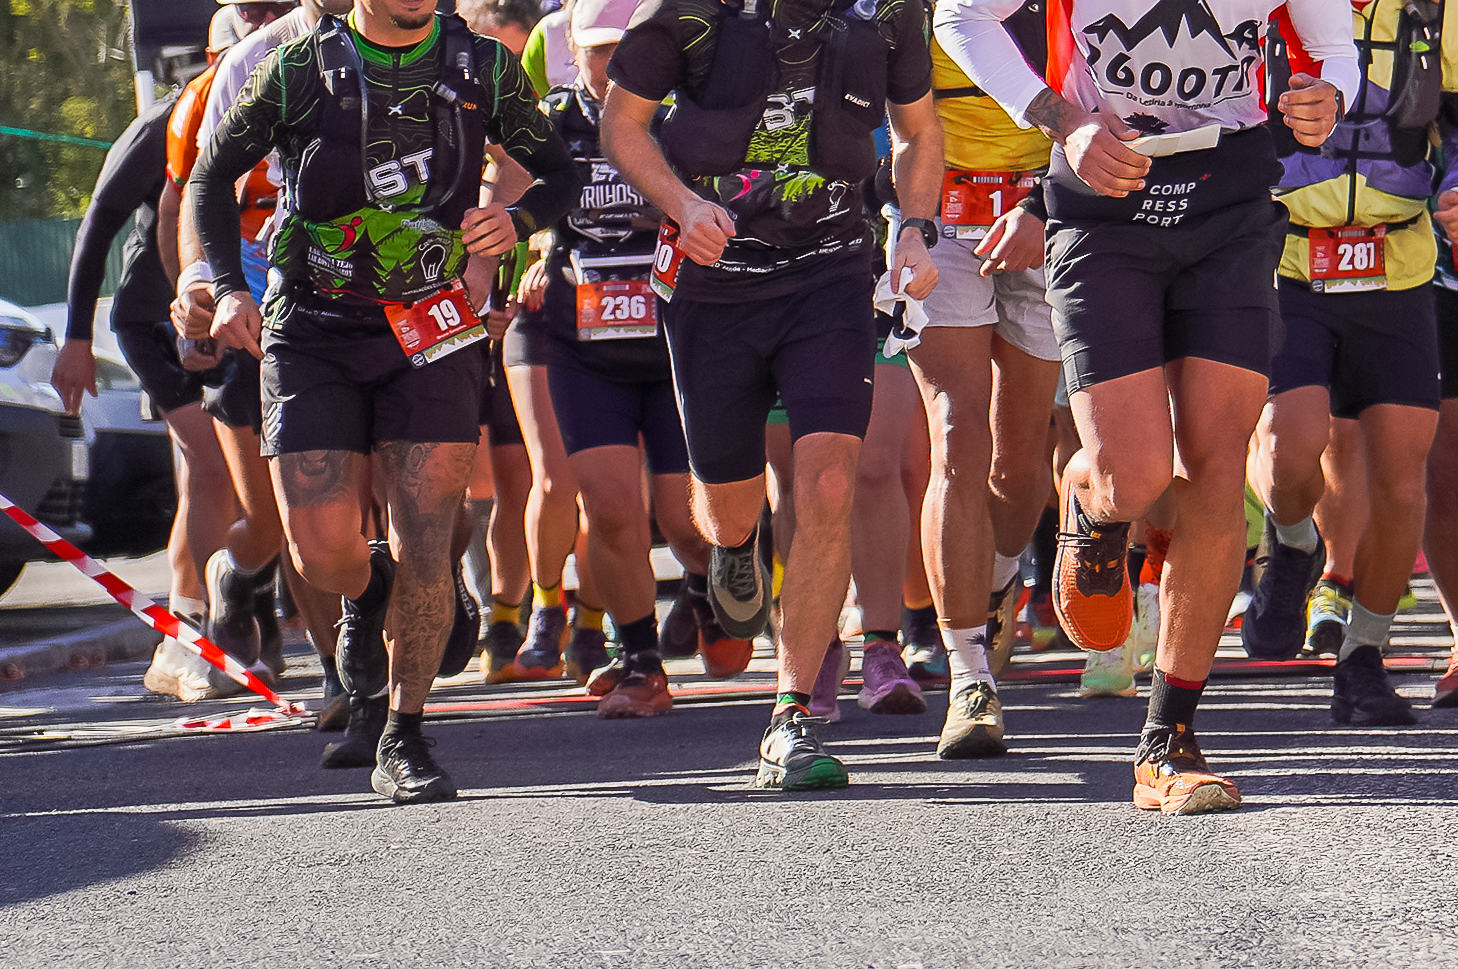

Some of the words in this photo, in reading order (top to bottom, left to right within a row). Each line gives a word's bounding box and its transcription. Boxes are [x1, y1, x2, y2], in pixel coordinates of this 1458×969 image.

[844, 93, 871, 108] EVADICT
[1149, 182, 1196, 196] COMP
[1142, 198, 1188, 212] RESS
[1132, 214, 1184, 228] PORT
[601, 295, 646, 321] 236
[428, 299, 461, 332] 19
